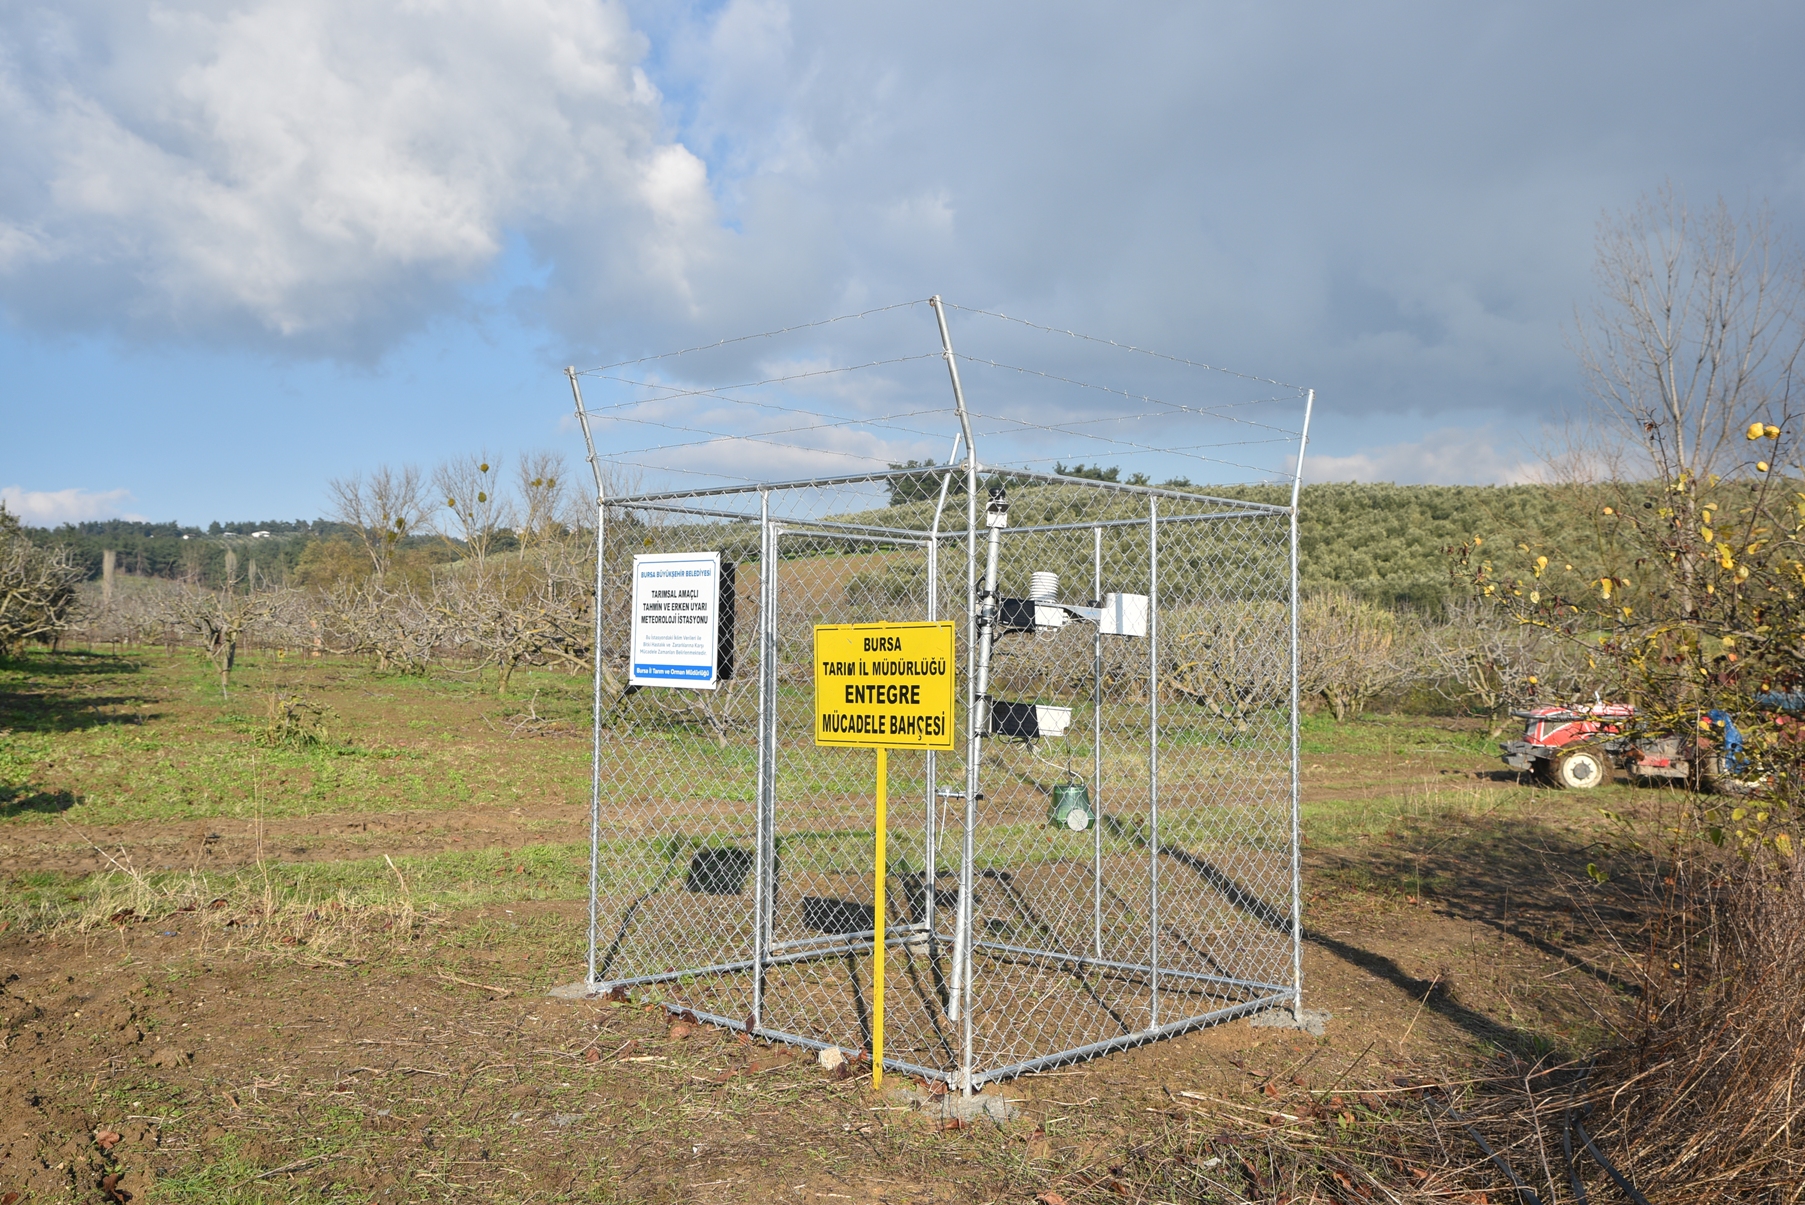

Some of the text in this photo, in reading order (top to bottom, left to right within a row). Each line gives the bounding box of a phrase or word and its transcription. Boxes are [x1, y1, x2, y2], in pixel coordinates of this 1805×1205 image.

[657, 569, 685, 579] BÜYÜKŞEHİR
[686, 568, 711, 577] BELEDİYESİ
[652, 590, 698, 600] TARIMSAL AMAÇLI
[643, 600, 662, 611] TAHMİN
[641, 613, 708, 624] METEOROLOJİ İSTASYONU
[864, 637, 902, 652] BURSA
[823, 657, 946, 676] TARIM İL MÜDÜRLÜĞÜ
[686, 669, 709, 677] Müdürlüğü
[845, 685, 920, 704] ENTEGRE
[822, 710, 945, 740] MÜCADELE BAHÇESİ
